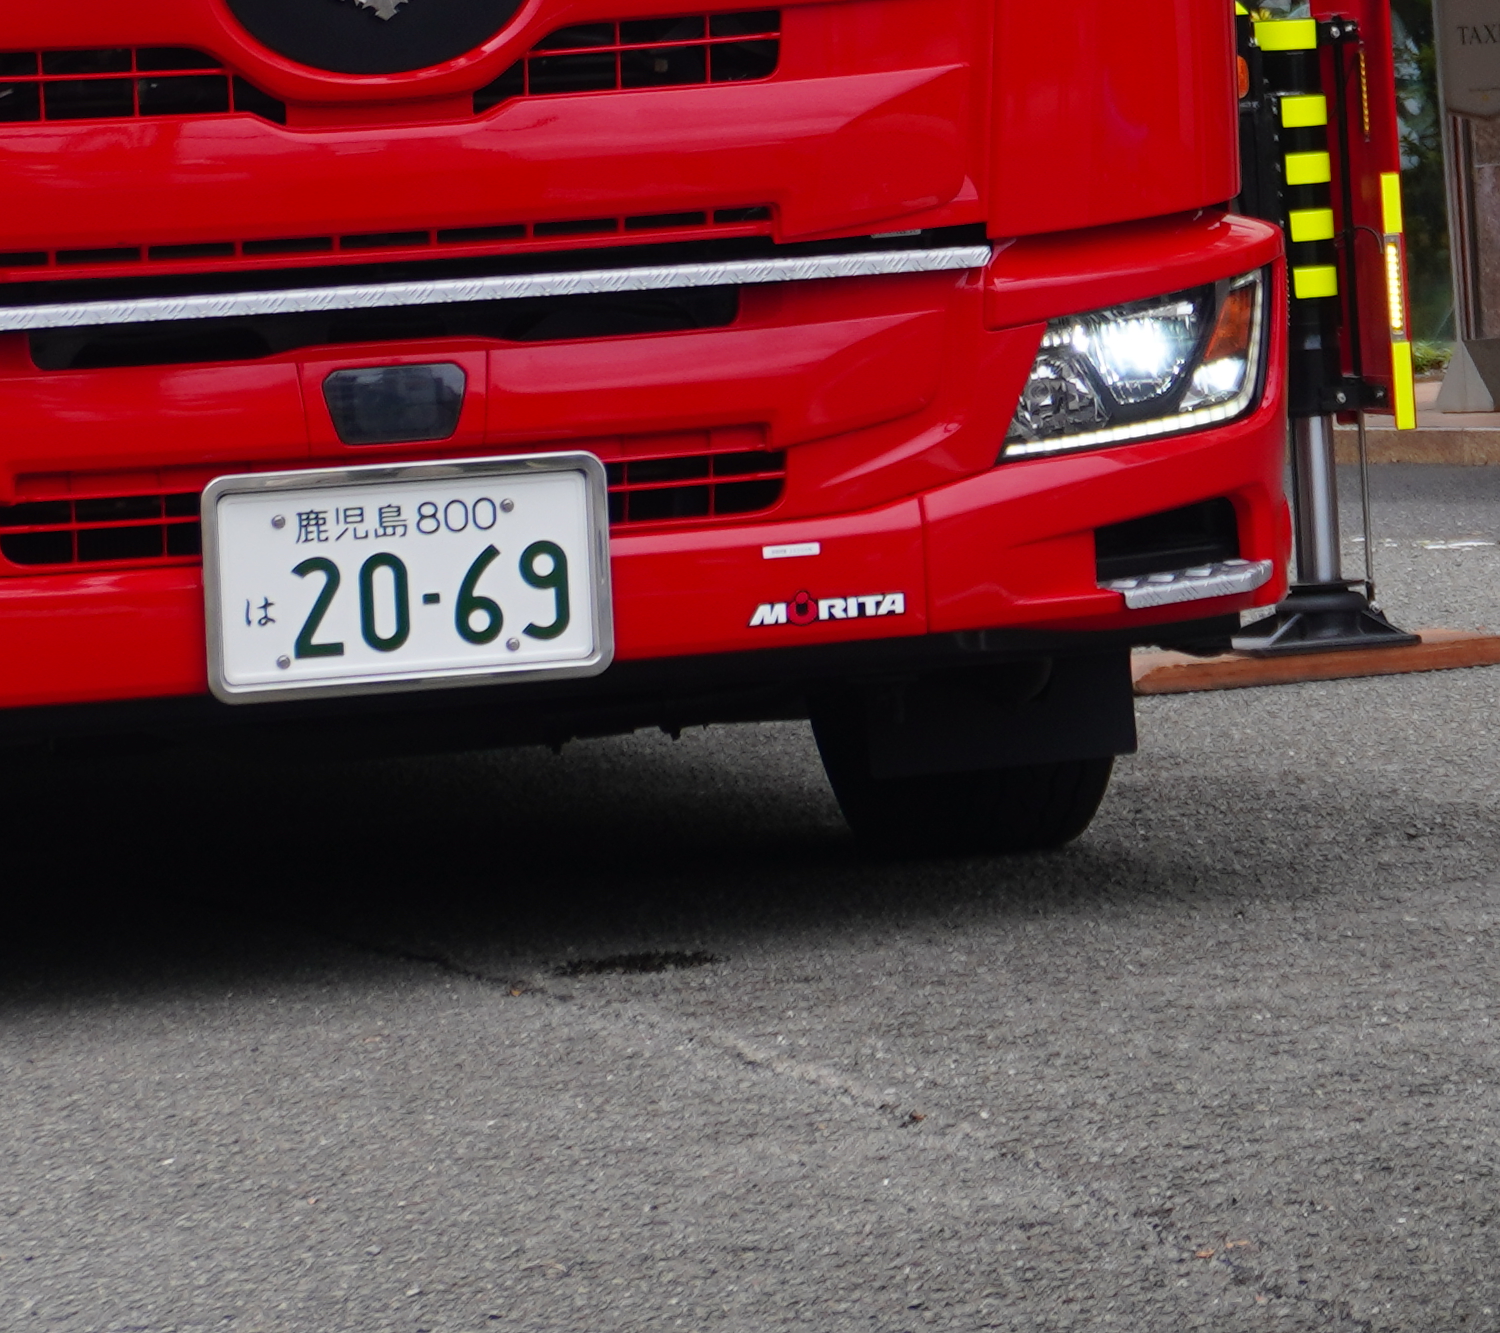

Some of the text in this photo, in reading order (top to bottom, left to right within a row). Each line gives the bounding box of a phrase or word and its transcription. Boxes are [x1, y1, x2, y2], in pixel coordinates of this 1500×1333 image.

[245, 540, 571, 661] は 20-69
[748, 590, 906, 627] MORITA
